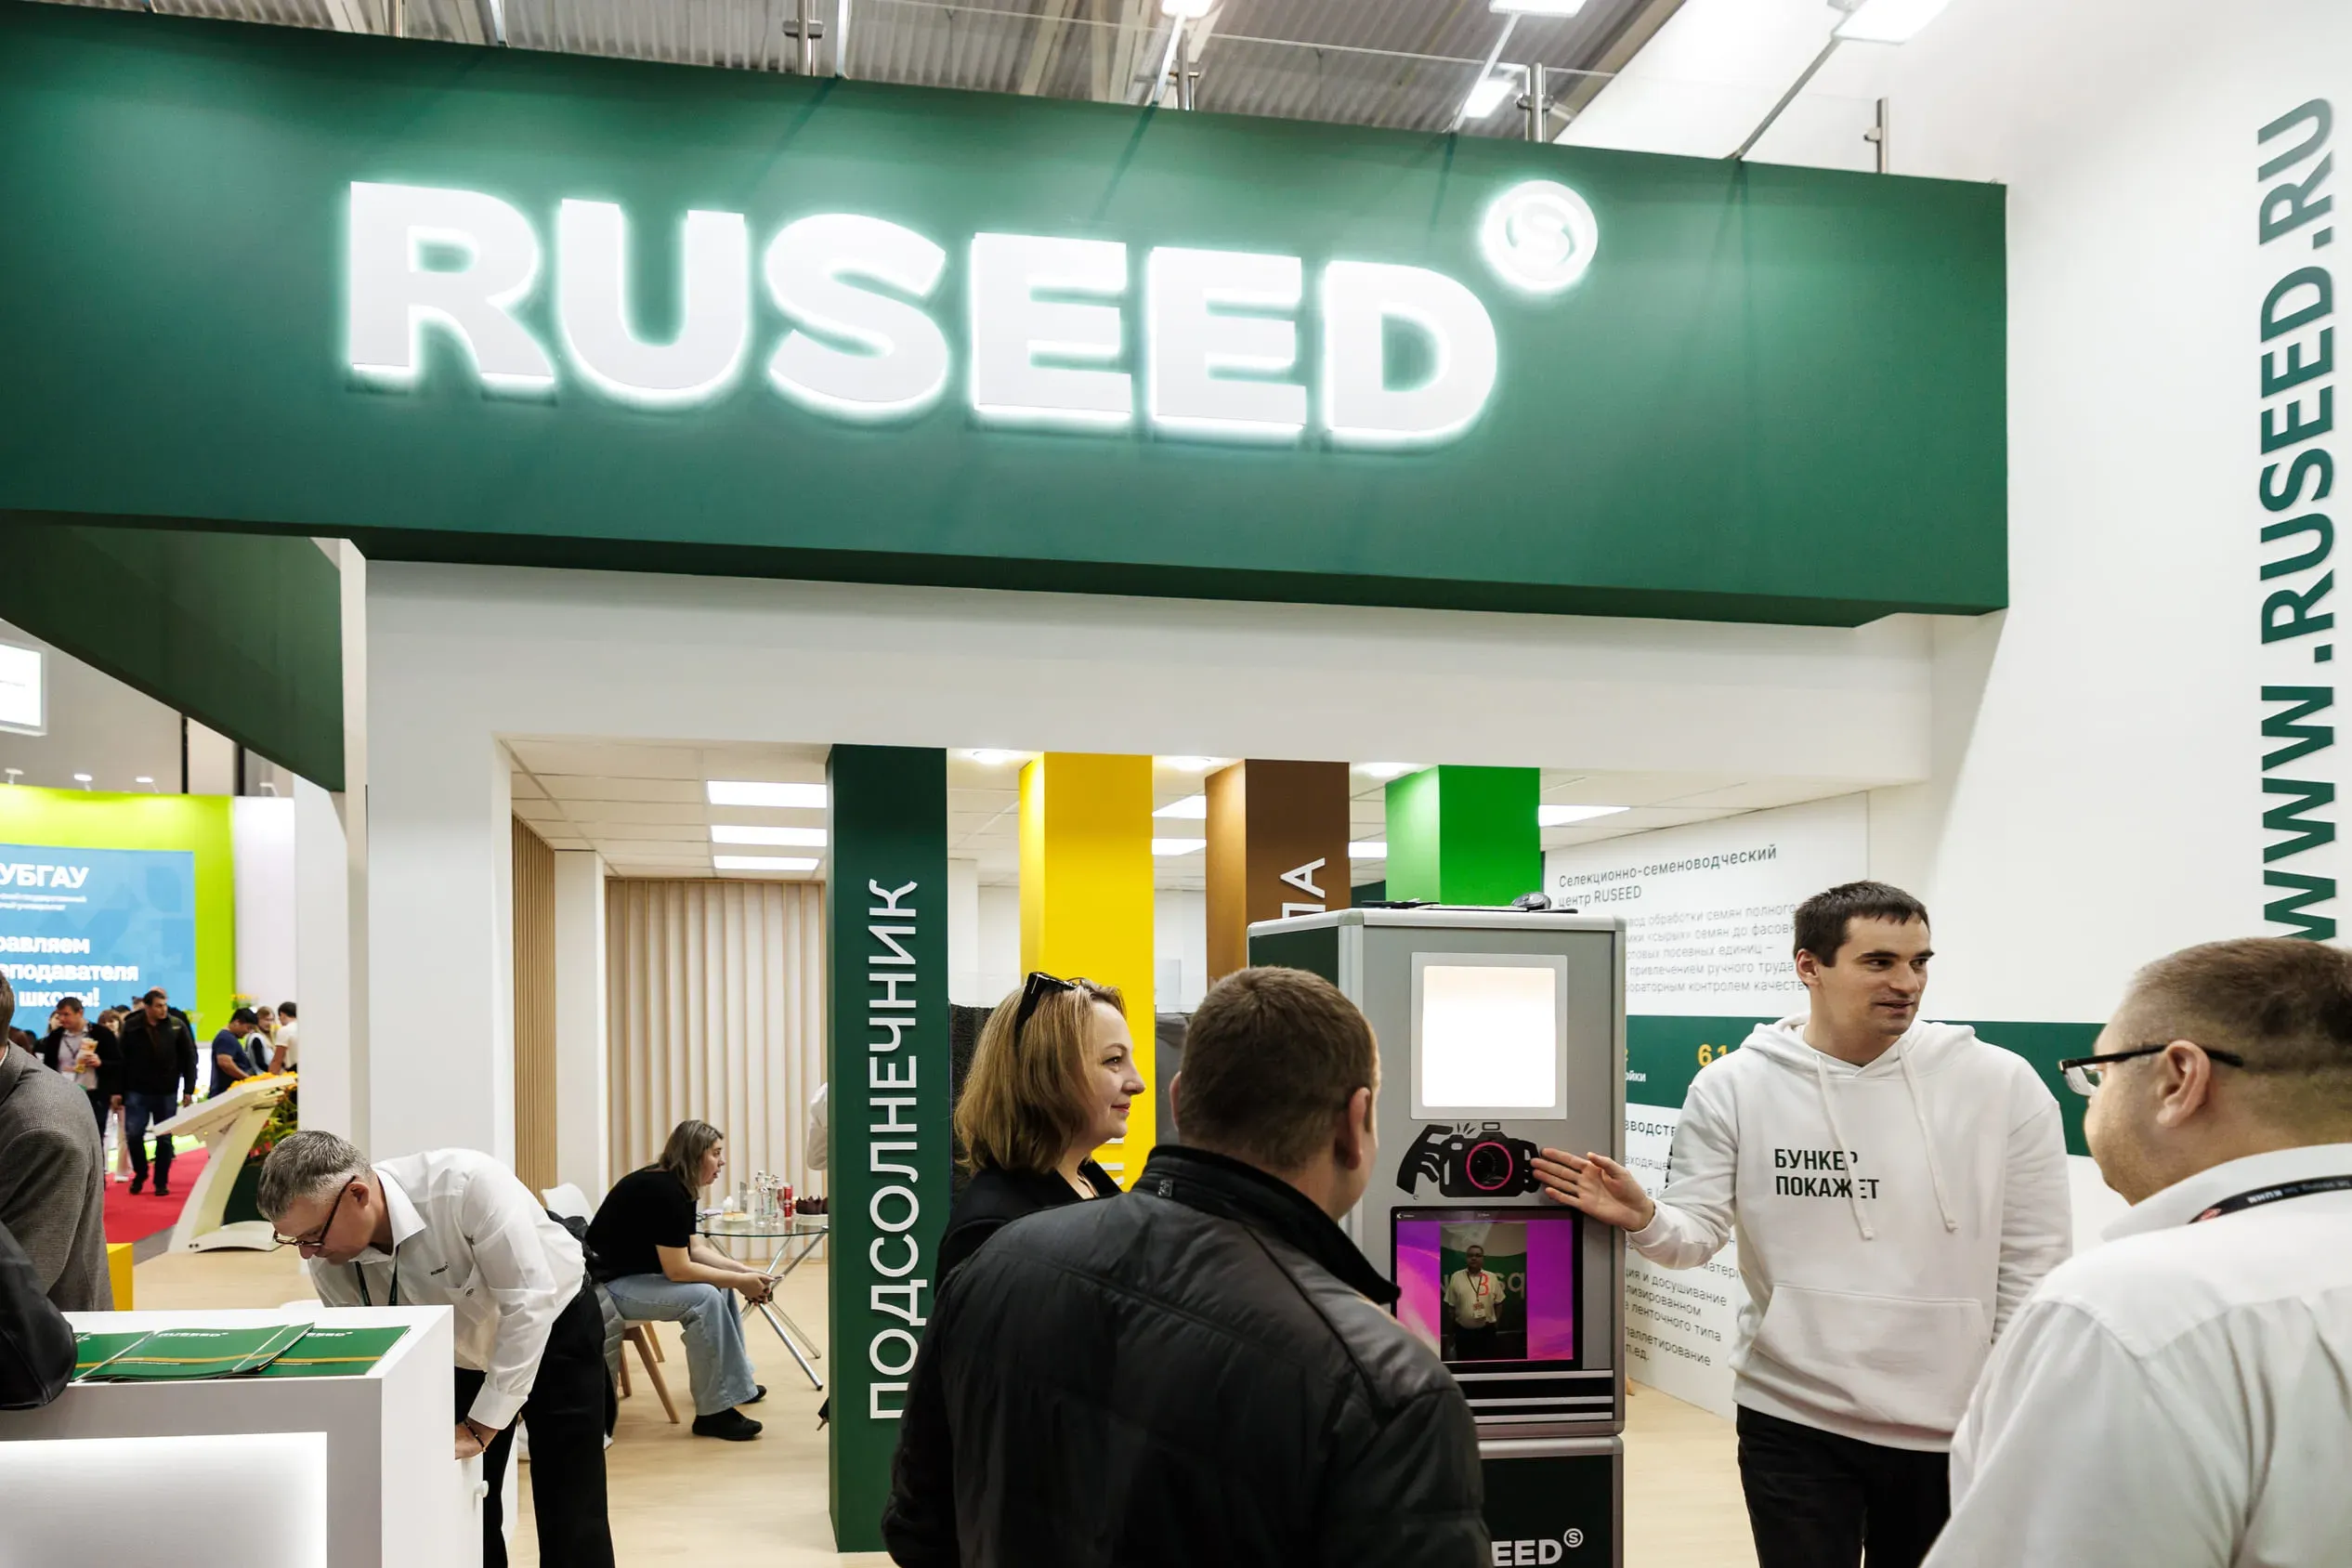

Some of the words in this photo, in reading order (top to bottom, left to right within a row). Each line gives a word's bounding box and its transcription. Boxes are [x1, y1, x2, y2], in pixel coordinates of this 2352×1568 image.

[349, 180, 1497, 439] RUSEED
[2257, 98, 2336, 941] WWW.RUSEED.RU
[0, 862, 89, 889] УБГАУ
[1559, 843, 1777, 887] Селекционно-семеноводческий
[1558, 893, 1591, 908] центр
[1594, 885, 1641, 903] RUSEED
[1627, 917, 1646, 928] вод
[1649, 910, 1704, 927] обработки
[1706, 908, 1742, 921] семян
[1745, 904, 1796, 918] полного
[1695, 928, 1730, 940] семян
[1732, 926, 1747, 939] до
[1664, 946, 1715, 959] посевных
[1719, 944, 1762, 956] единиц
[1629, 964, 1704, 977] привлечением
[1707, 962, 1754, 977] ручного
[1689, 981, 1750, 994] контролем
[869, 879, 927, 1419] ПОДСОЛНЕЧНИК
[1776, 1175, 1880, 1199] ПОКАЖЕТ
[1652, 1275, 1728, 1306] досушивание
[1631, 1302, 1692, 1332] ленточного
[1695, 1325, 1722, 1342] типа
